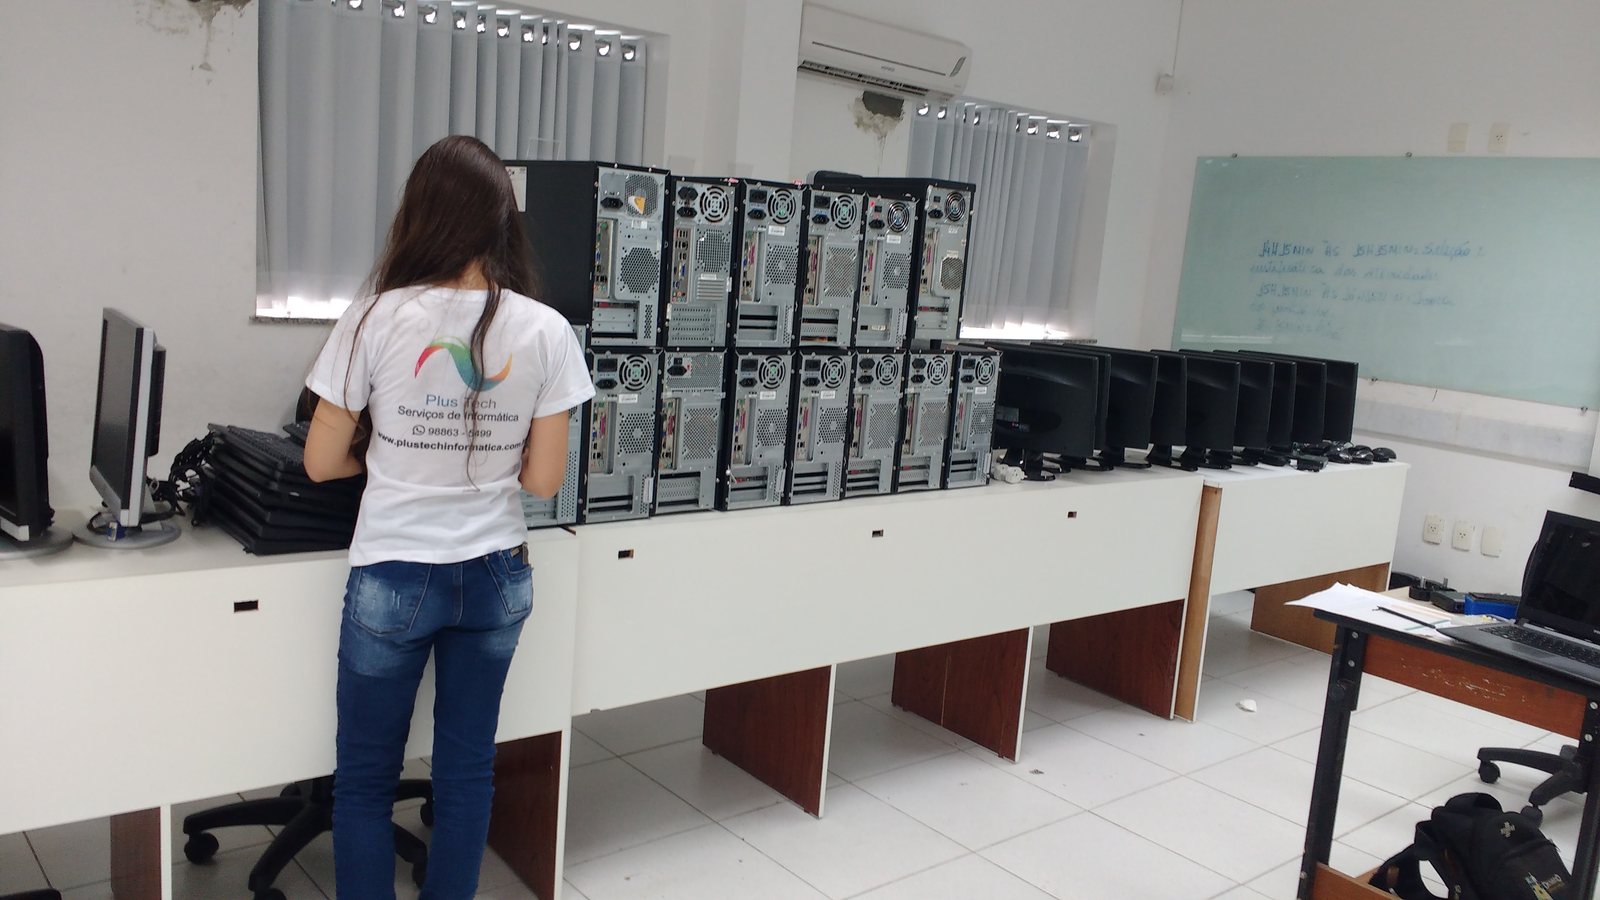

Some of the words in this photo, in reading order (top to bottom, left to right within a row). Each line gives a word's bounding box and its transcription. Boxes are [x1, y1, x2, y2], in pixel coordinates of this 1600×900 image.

[425, 394, 459, 408] Plus
[464, 396, 497, 410] Tech
[397, 405, 445, 421] Serviços
[447, 409, 461, 421] de
[428, 427, 460, 438] 98863
[468, 429, 492, 438] 5499
